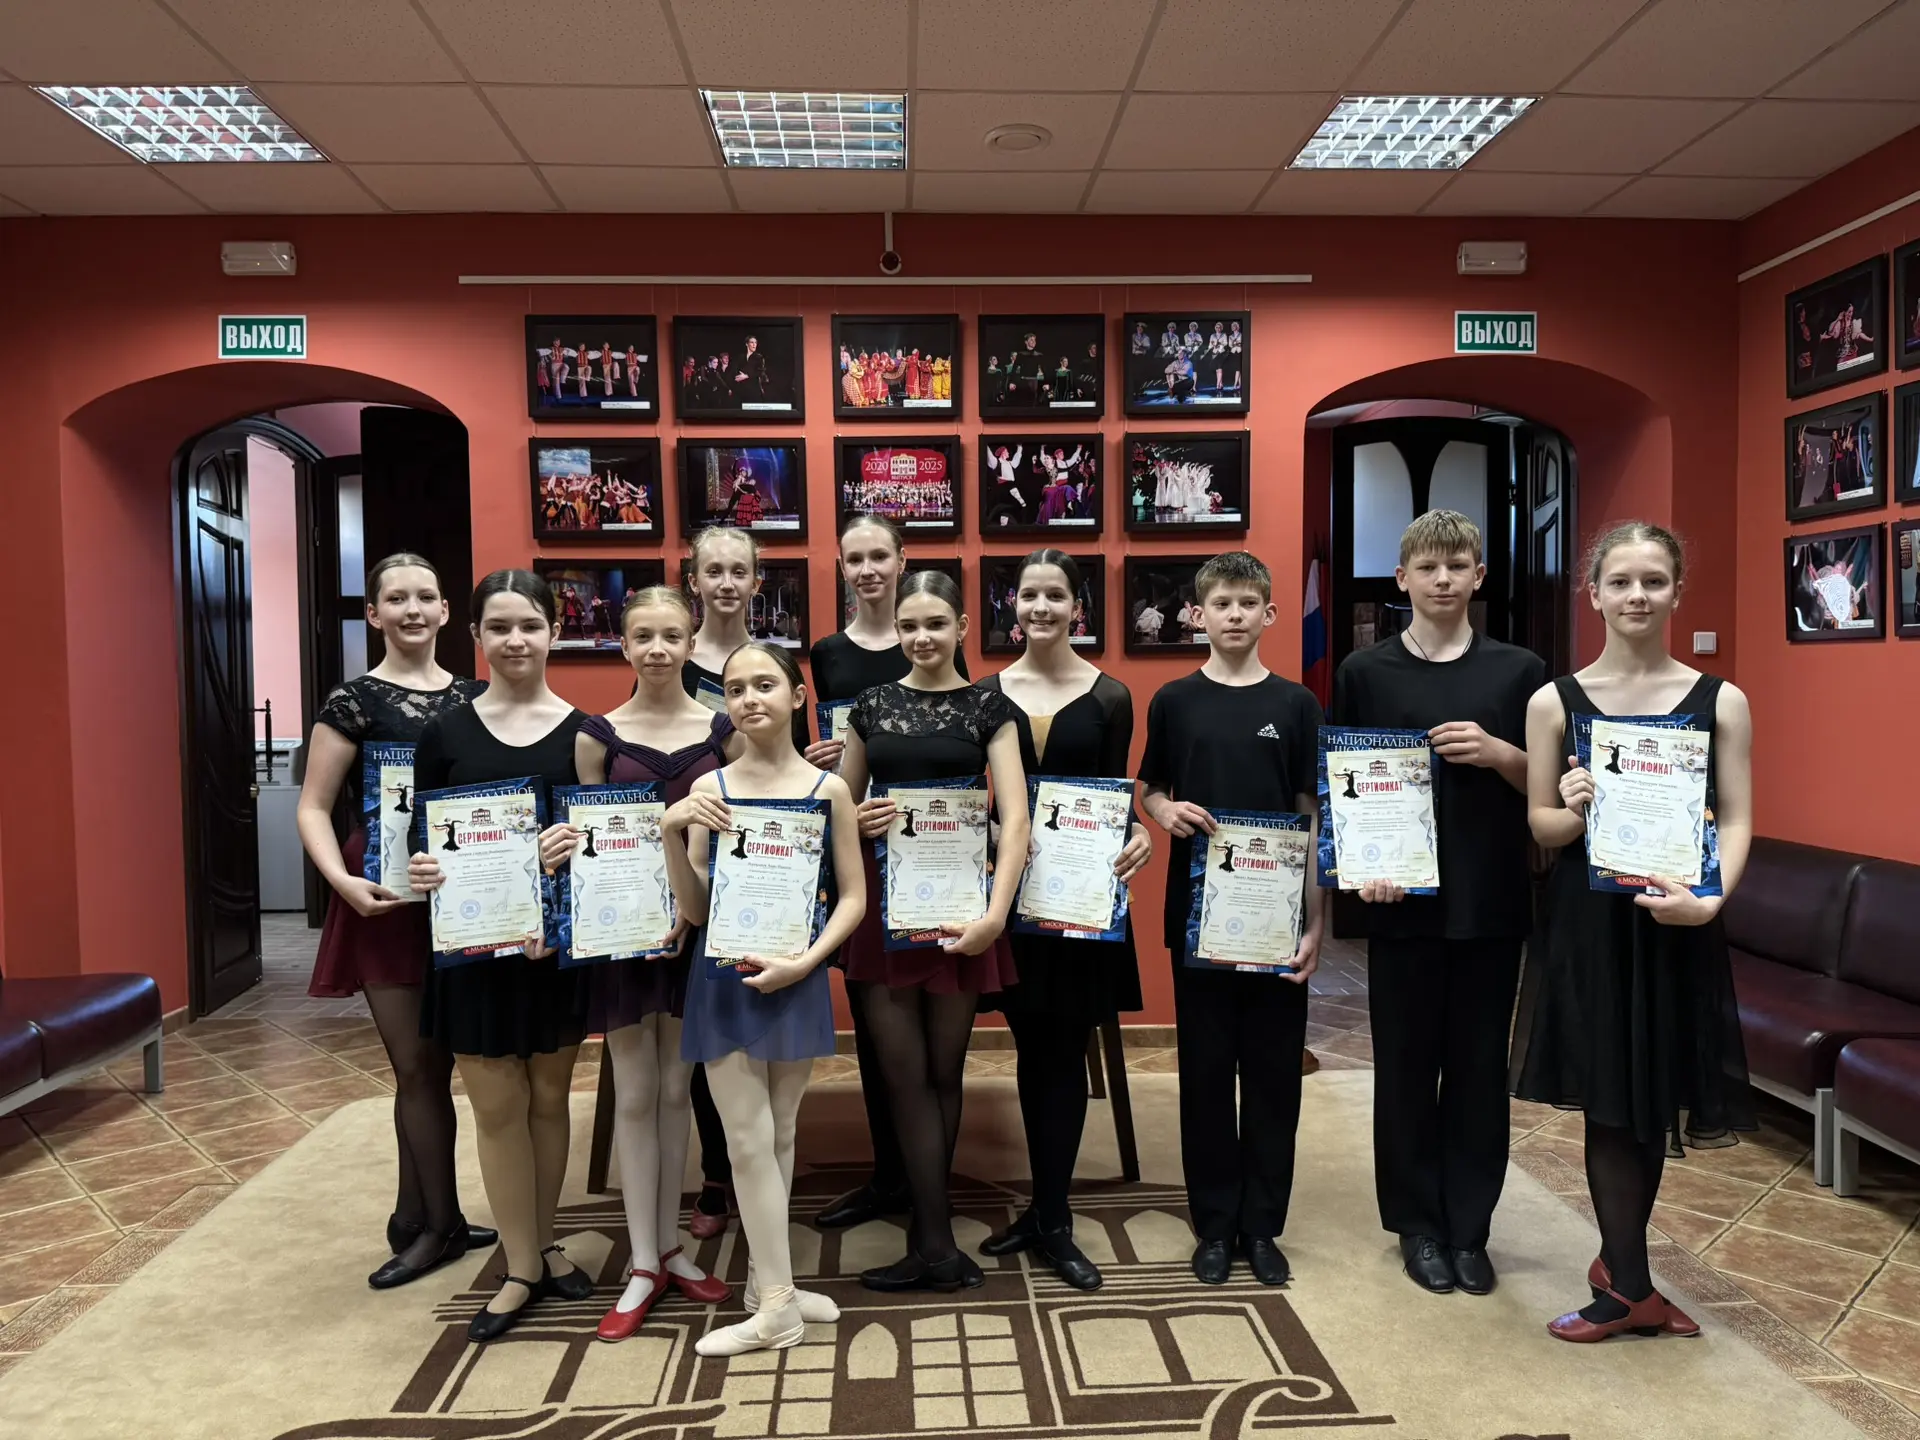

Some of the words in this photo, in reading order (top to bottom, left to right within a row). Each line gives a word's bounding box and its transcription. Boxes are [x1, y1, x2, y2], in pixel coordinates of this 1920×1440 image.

[226, 325, 302, 352] ВЫХОД
[1461, 320, 1532, 348] ВЫХОД
[865, 461, 889, 471] 2020
[919, 461, 943, 471] 2025
[1327, 734, 1431, 748] НАЦИОНАЛЬНОЕ
[1621, 758, 1674, 776] СЕРТИФИКАТ
[1356, 780, 1403, 793] СЕРТИФИКАТ
[562, 791, 658, 807] НАЦИОНАЛЬНОЕ
[915, 820, 960, 832] СЕРТИФИКАТ
[1059, 816, 1101, 832] СЕРТИФИКАТ
[1213, 817, 1302, 832] ЦИОНАЛЬНОЕ
[458, 829, 508, 845] СЕРТИФИКАТ
[595, 837, 640, 851] СЕРТИФИКАТ
[746, 842, 795, 857] СЕРТИФИКАТ
[1233, 856, 1278, 871] СЕРТИФИКАТ
